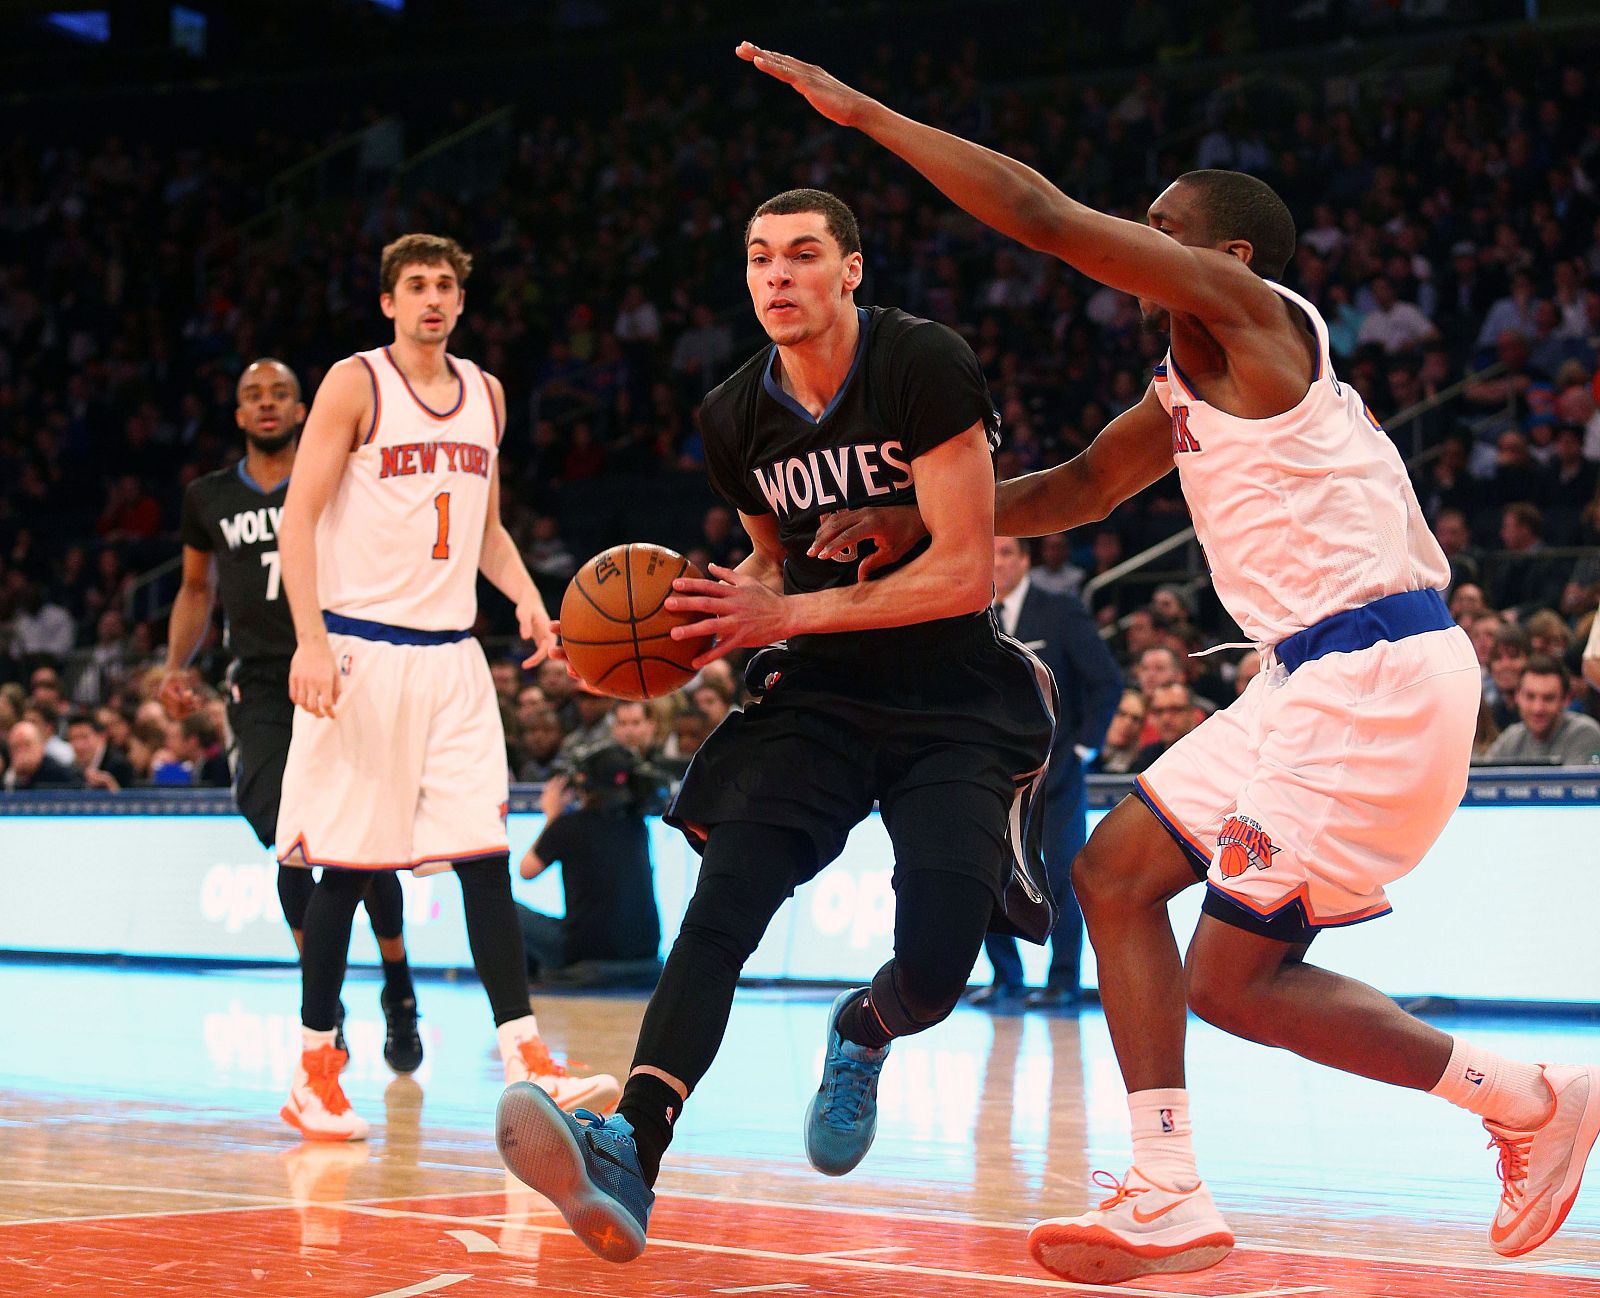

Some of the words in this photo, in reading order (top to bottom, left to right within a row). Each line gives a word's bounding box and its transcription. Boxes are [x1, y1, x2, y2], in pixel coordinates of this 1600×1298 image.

[379, 442, 438, 478] NEW
[753, 441, 914, 519] WOLVES
[432, 492, 450, 560] 1
[260, 550, 282, 601] 7
[1217, 816, 1272, 868] KNICKS
